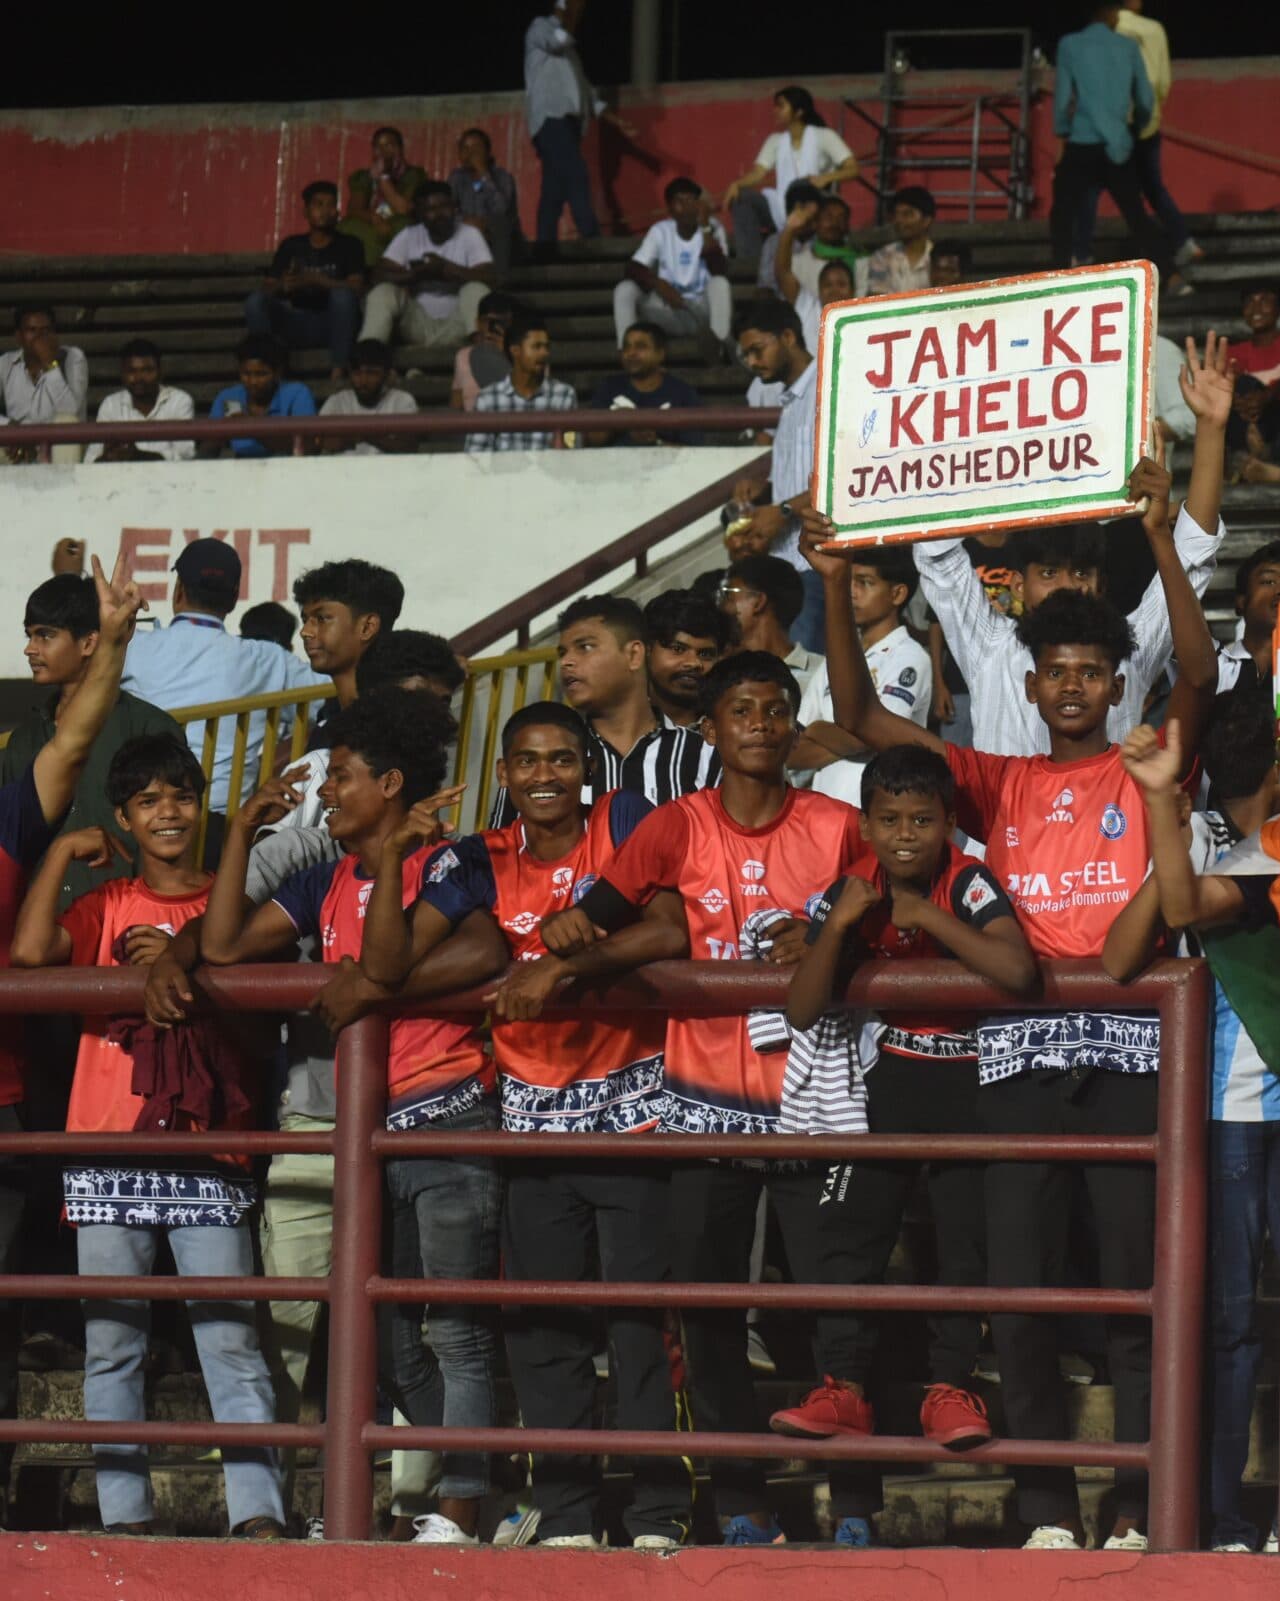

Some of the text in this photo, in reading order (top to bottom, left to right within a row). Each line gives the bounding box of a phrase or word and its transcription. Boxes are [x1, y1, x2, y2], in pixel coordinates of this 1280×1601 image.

[889, 369, 1088, 448] KHELO
[848, 433, 1099, 498] JAMSHEDPUR
[119, 527, 311, 602] EIT
[739, 884, 768, 896] TATA
[1060, 861, 1126, 896] STEEL
